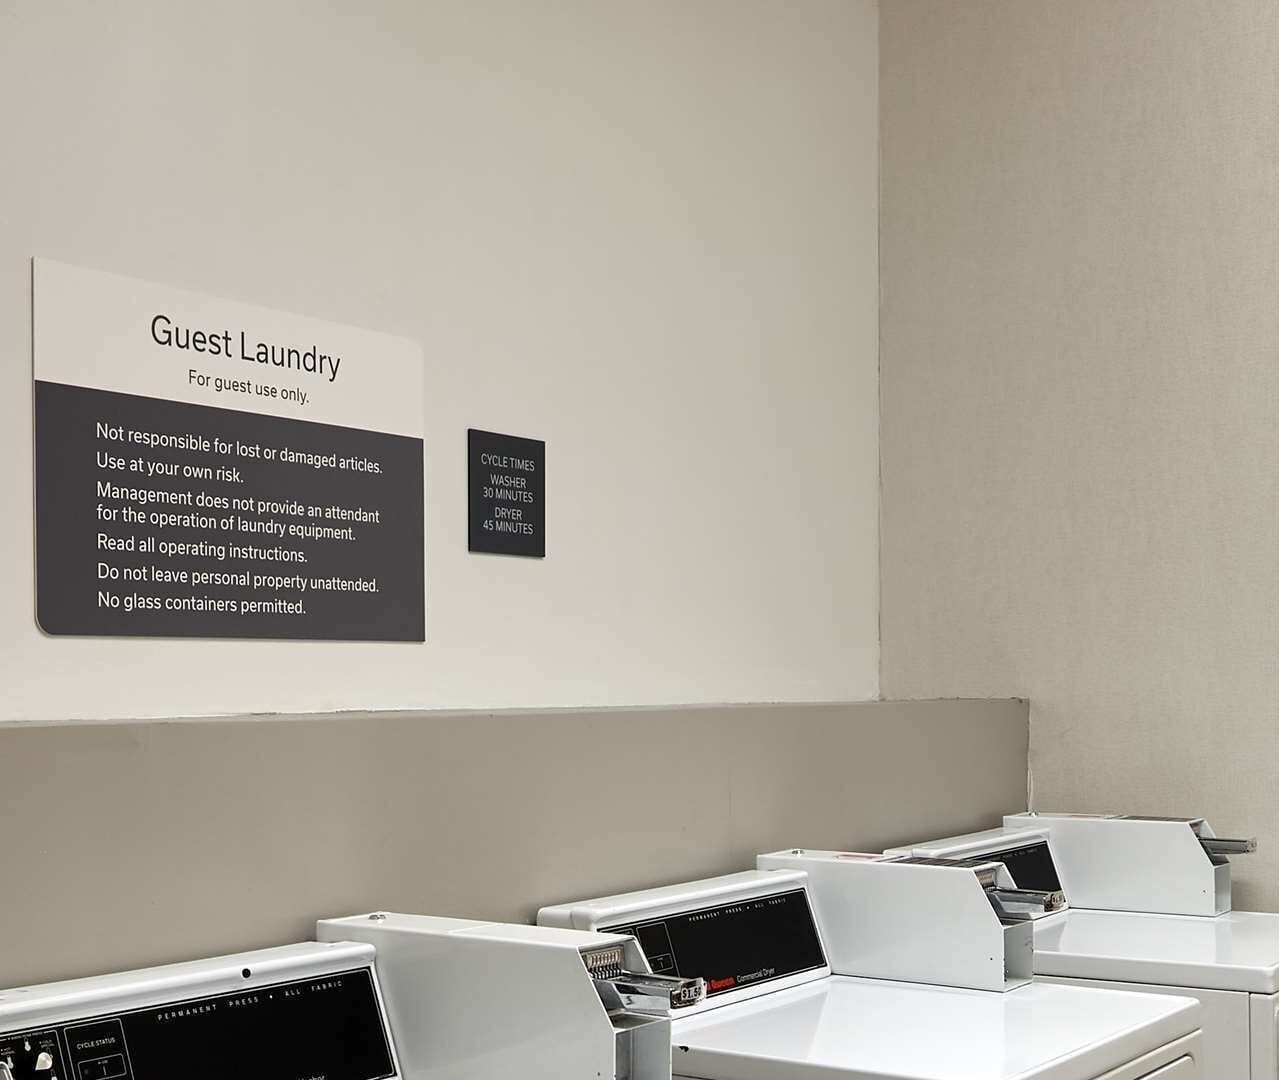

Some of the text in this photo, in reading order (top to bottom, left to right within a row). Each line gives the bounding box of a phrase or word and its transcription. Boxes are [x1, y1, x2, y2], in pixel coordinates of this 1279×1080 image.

[151, 315, 341, 382] Guest Laundry
[189, 369, 310, 405] For guest use only.
[96, 422, 383, 474] Not responsible for lost or damaged articles.
[481, 453, 535, 472] CYCLE TIMES
[96, 451, 244, 483] Use at your own risk.
[490, 473, 526, 489] WASHER
[96, 481, 380, 523] Management does not provide an attendant
[483, 487, 534, 503] 30 MINUTES
[96, 504, 356, 540] for the operation of laundry equipment.
[483, 520, 534, 535] 45 MINUTES
[494, 507, 522, 520] DRYER
[97, 533, 308, 562] Read all operating instructions.
[97, 562, 379, 593] Do not leave personal property unattended.
[98, 591, 306, 615] No glass containers permitted.
[157, 980, 343, 1021] PERMANENT PRESS ALL FABRIC
[77, 1037, 116, 1050] CYCLE STATUS
